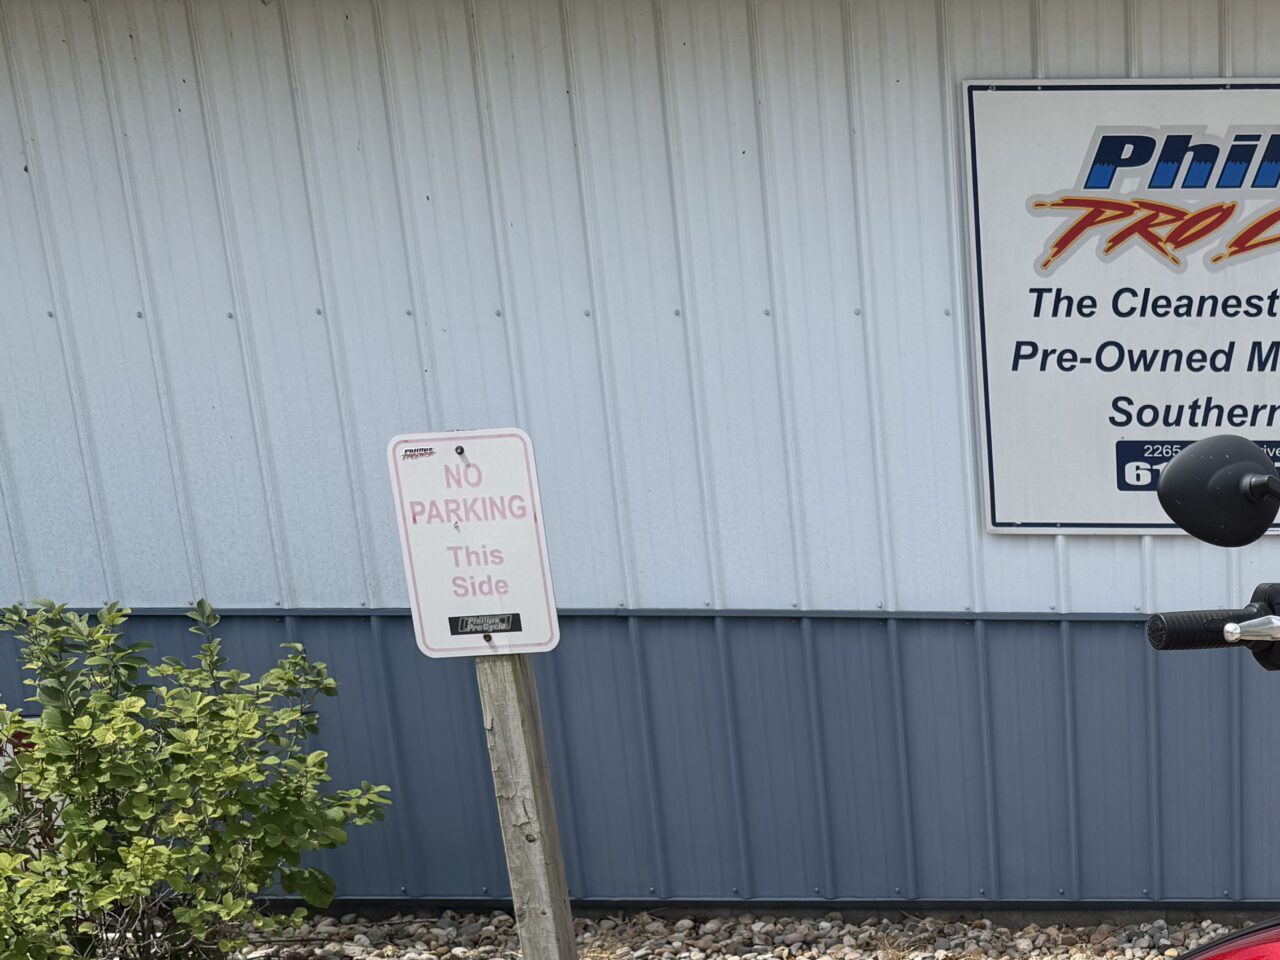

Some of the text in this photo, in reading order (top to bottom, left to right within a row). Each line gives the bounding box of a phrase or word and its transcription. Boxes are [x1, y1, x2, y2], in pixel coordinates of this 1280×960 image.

[1032, 196, 1237, 270] PRO
[1028, 288, 1098, 318] The
[1111, 287, 1280, 318] Cleanest
[1011, 341, 1234, 372] Pre-Owned
[1143, 444, 1181, 457] 2265
[443, 463, 483, 489] NO
[409, 495, 528, 525] PARKING
[446, 545, 505, 568] This
[452, 575, 510, 598] Side
